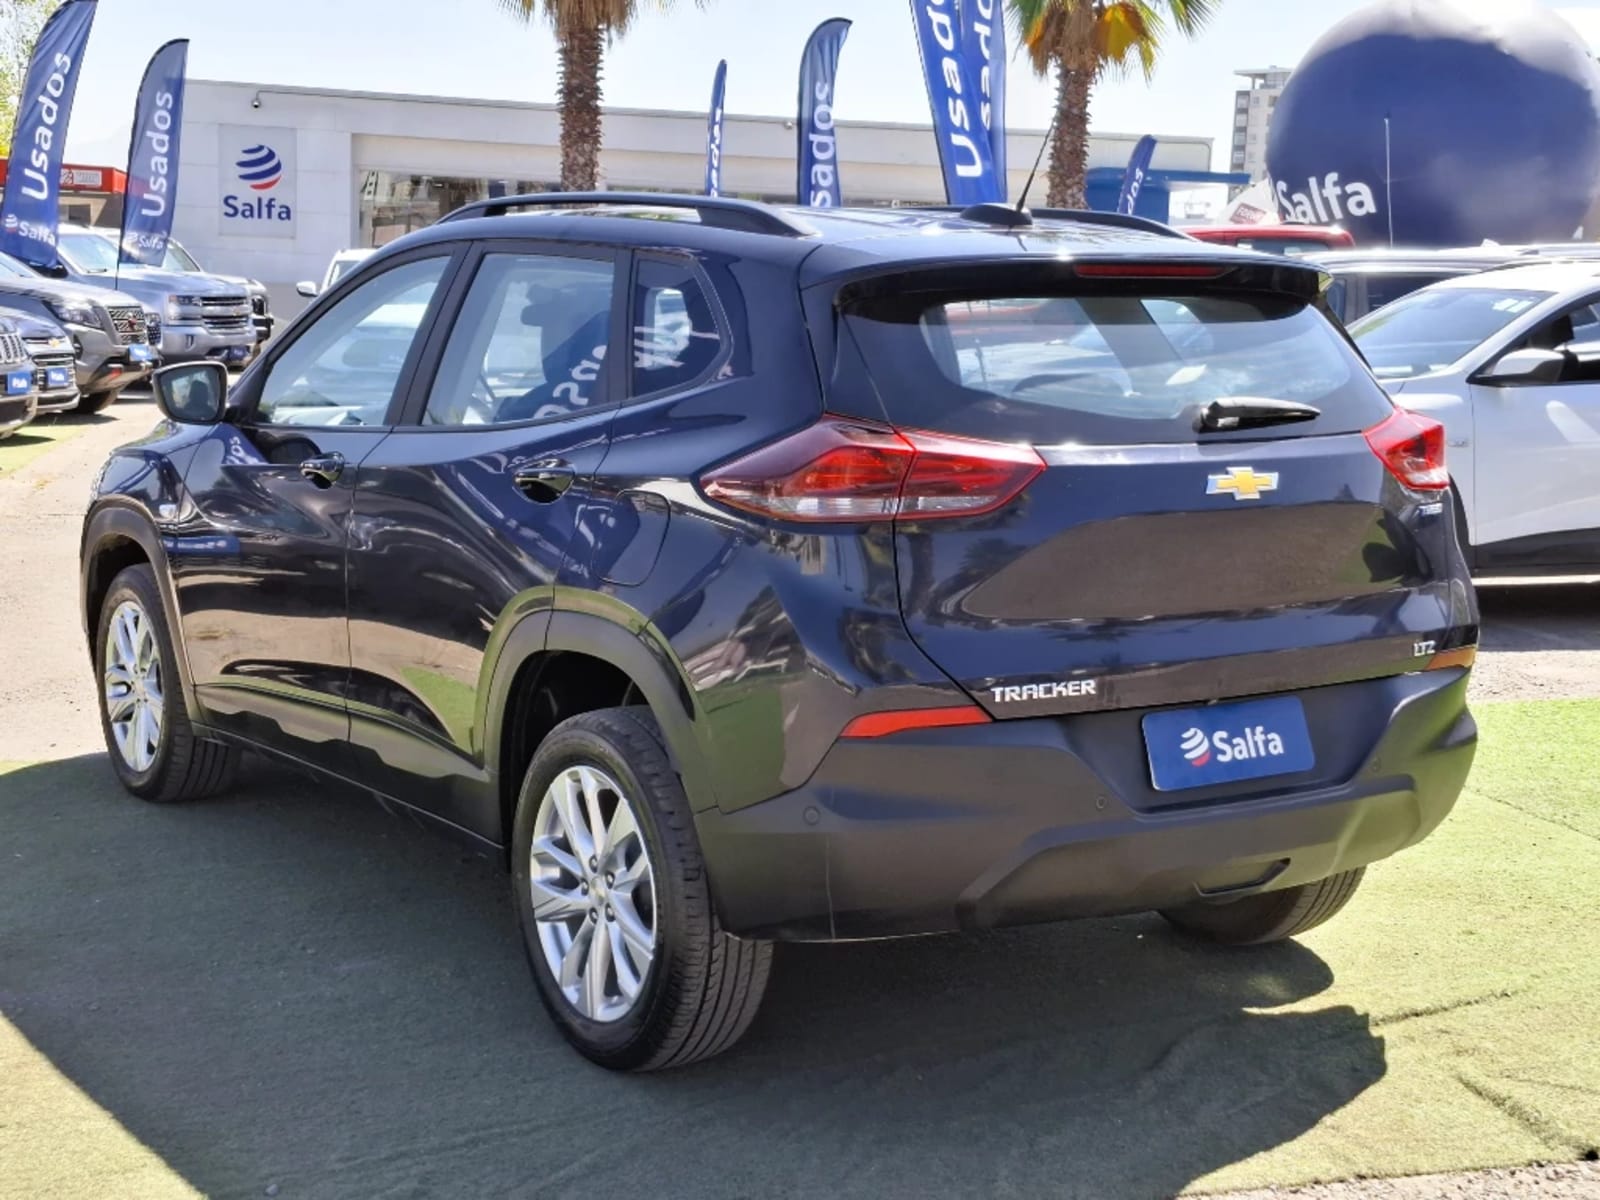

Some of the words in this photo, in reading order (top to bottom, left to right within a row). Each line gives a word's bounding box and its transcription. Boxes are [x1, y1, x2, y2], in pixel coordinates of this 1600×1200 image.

[926, 0, 982, 177] Usad
[22, 52, 72, 200] Usados
[141, 91, 173, 217] Usados
[223, 195, 292, 221] Salfa
[1276, 172, 1377, 225] Salfa
[18, 221, 56, 246] Salfa
[1413, 640, 1436, 657] LTZ
[990, 679, 1097, 703] TRACKER
[1212, 725, 1285, 763] Salfa
